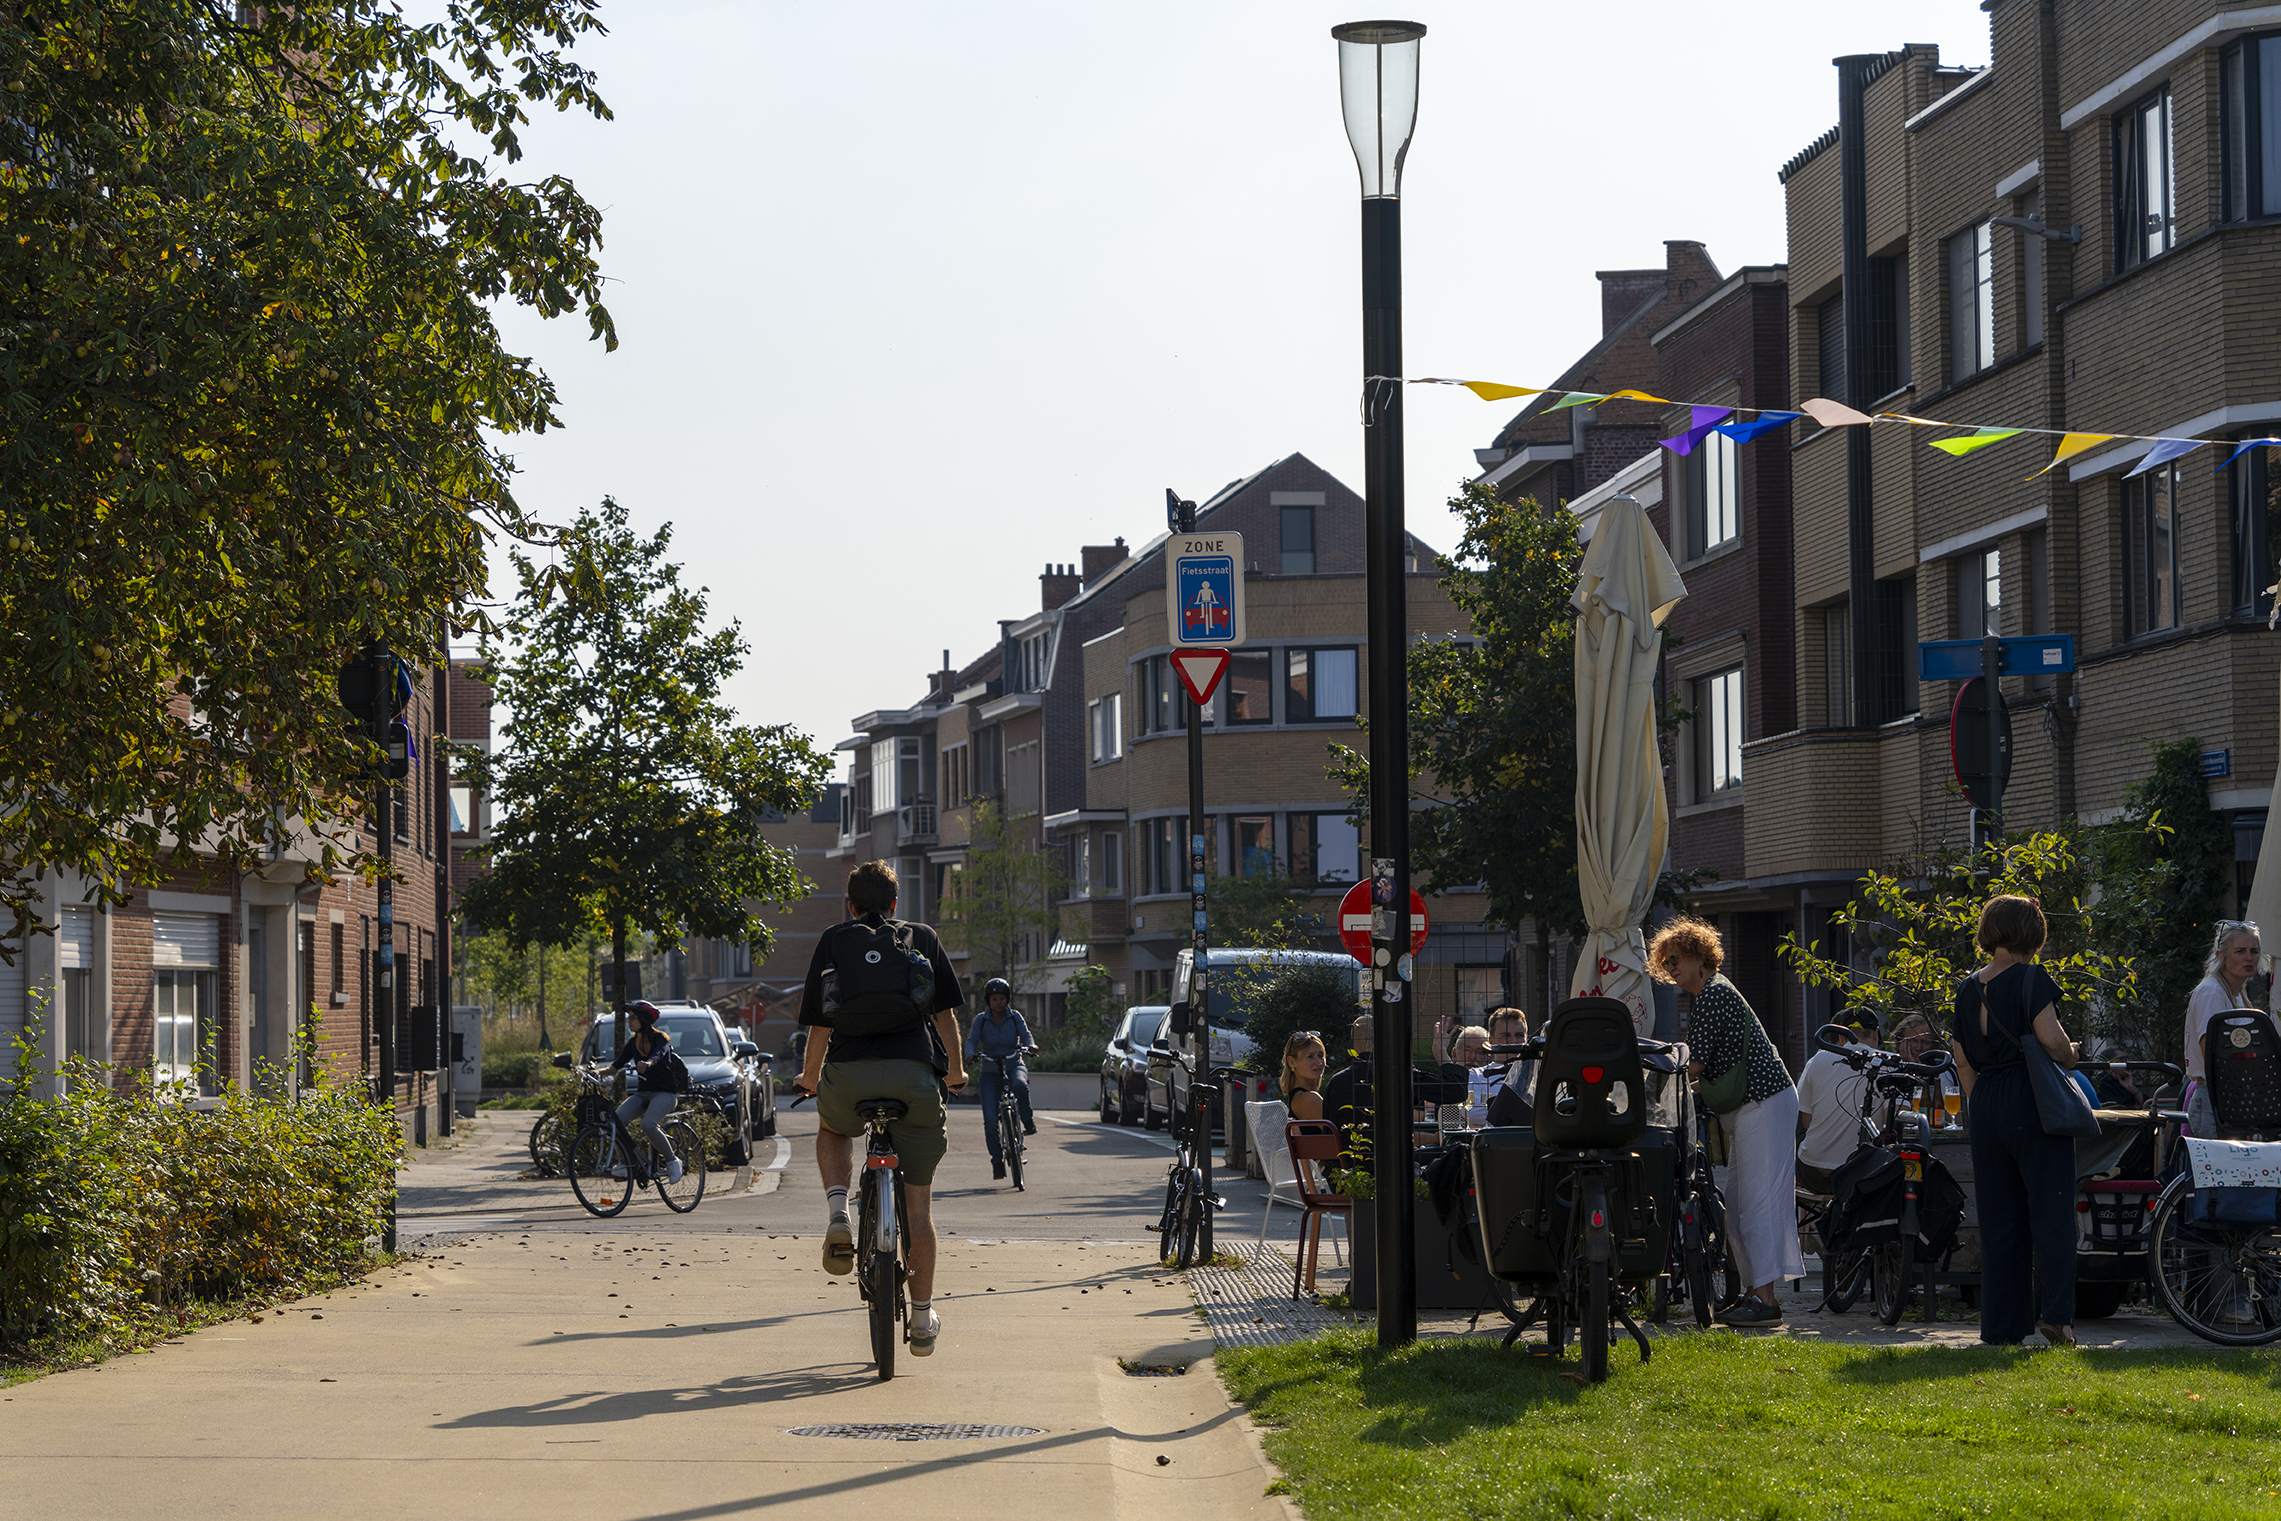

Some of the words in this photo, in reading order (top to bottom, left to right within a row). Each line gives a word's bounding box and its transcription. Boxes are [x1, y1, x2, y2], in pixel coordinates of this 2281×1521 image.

[1185, 541, 1224, 553] ZONE
[1182, 566, 1229, 576] Fietsstraat
[2097, 1209, 2138, 1219] chaiot
